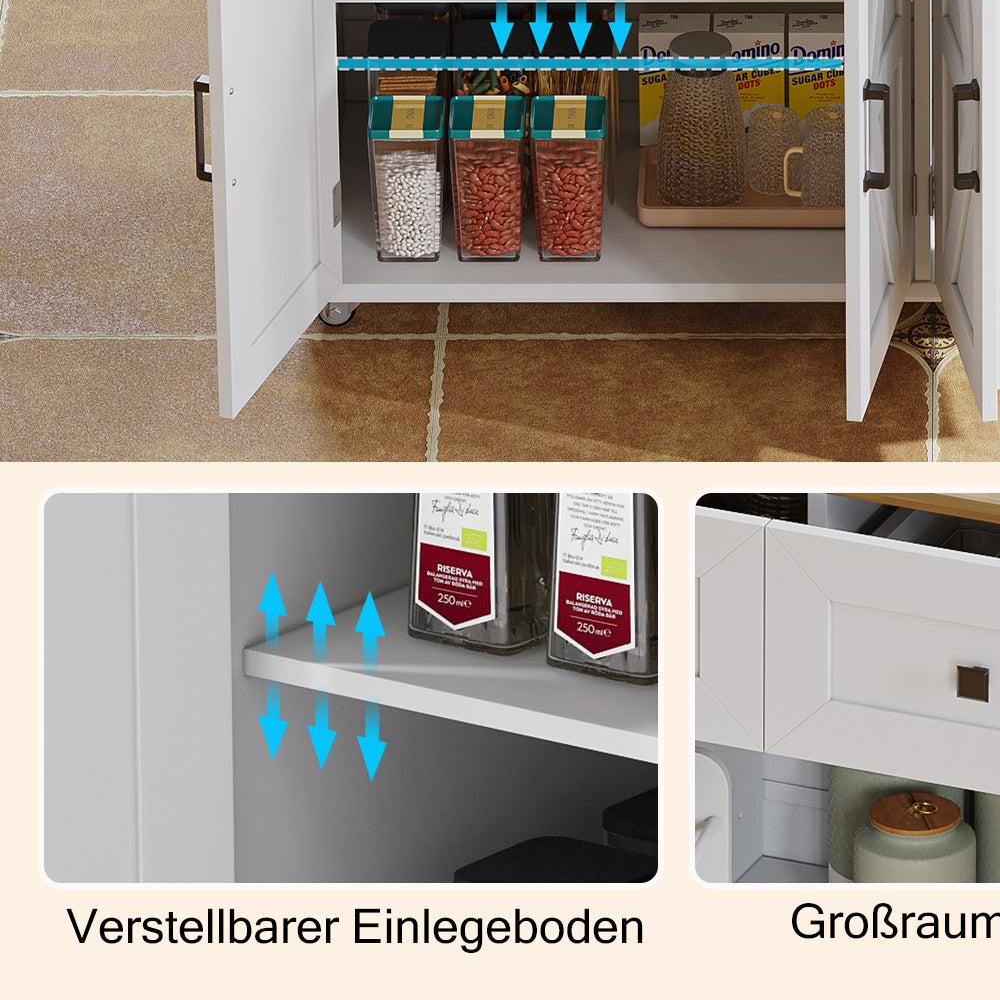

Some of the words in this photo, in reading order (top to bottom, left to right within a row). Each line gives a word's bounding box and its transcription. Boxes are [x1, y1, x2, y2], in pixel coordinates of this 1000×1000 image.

[738, 79, 761, 90] DOTS
[792, 71, 823, 86] SUGAR
[813, 79, 836, 90] DOTS
[437, 563, 473, 579] RISERVA
[437, 592, 456, 606] 250
[576, 592, 613, 607] RISERVA
[576, 621, 595, 634] 250
